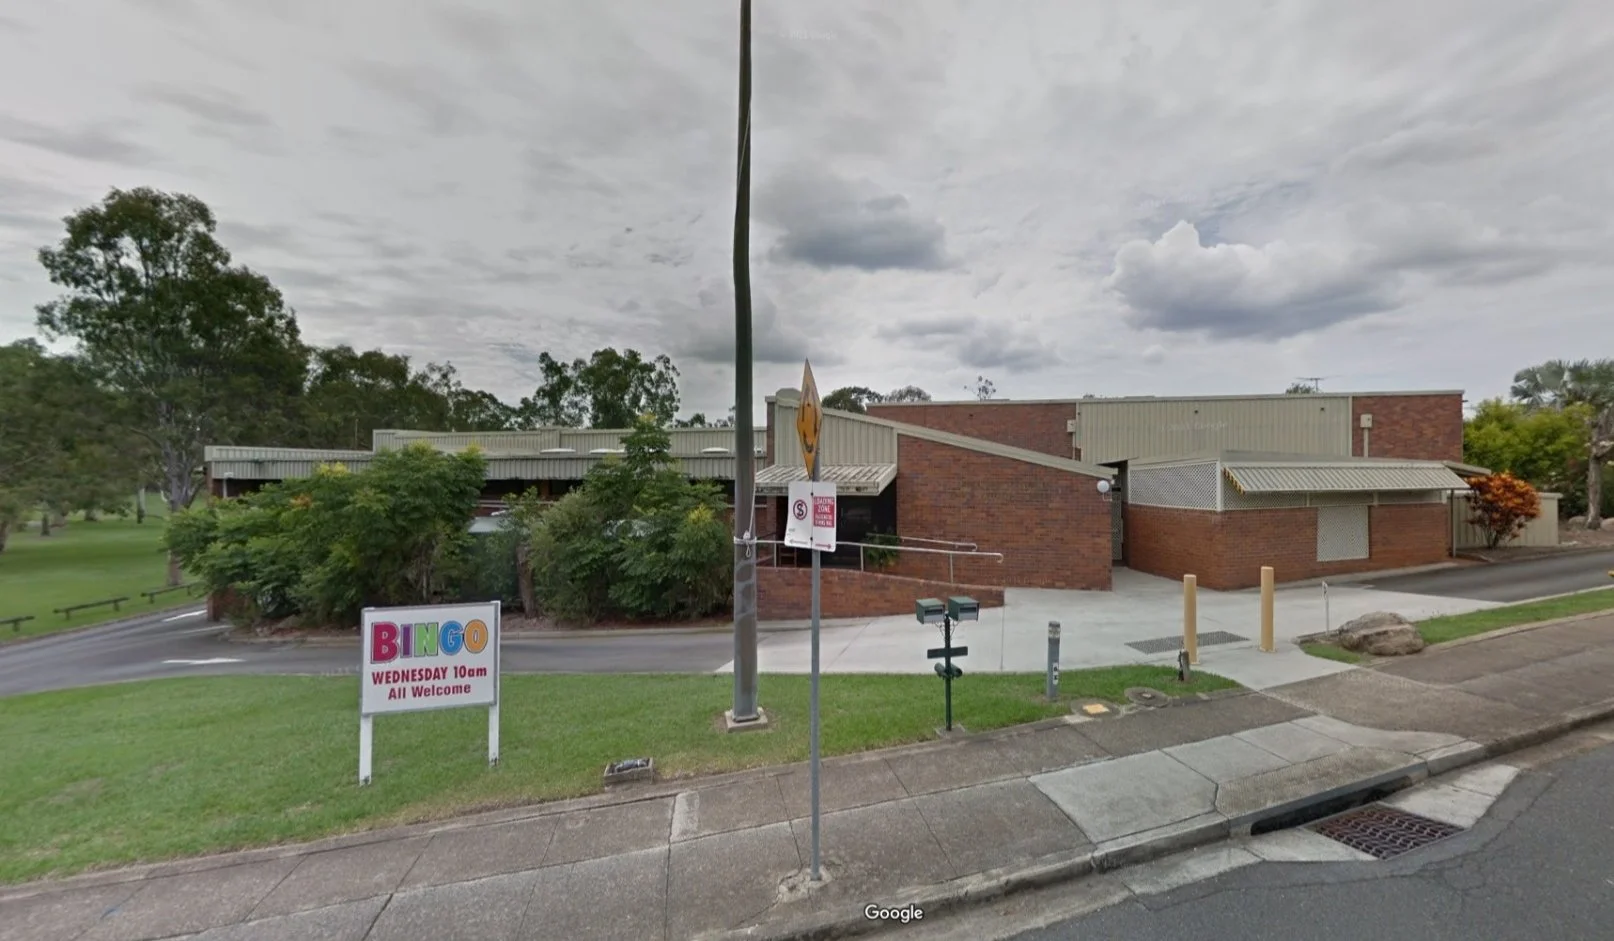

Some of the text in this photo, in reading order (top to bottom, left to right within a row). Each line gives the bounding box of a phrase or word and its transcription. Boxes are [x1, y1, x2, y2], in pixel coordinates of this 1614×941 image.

[817, 505, 831, 513] ZONE
[370, 619, 489, 664] BINGO
[372, 666, 448, 685] WEDNESDAY
[453, 665, 487, 679] 10am
[388, 683, 471, 700] All Welcome
